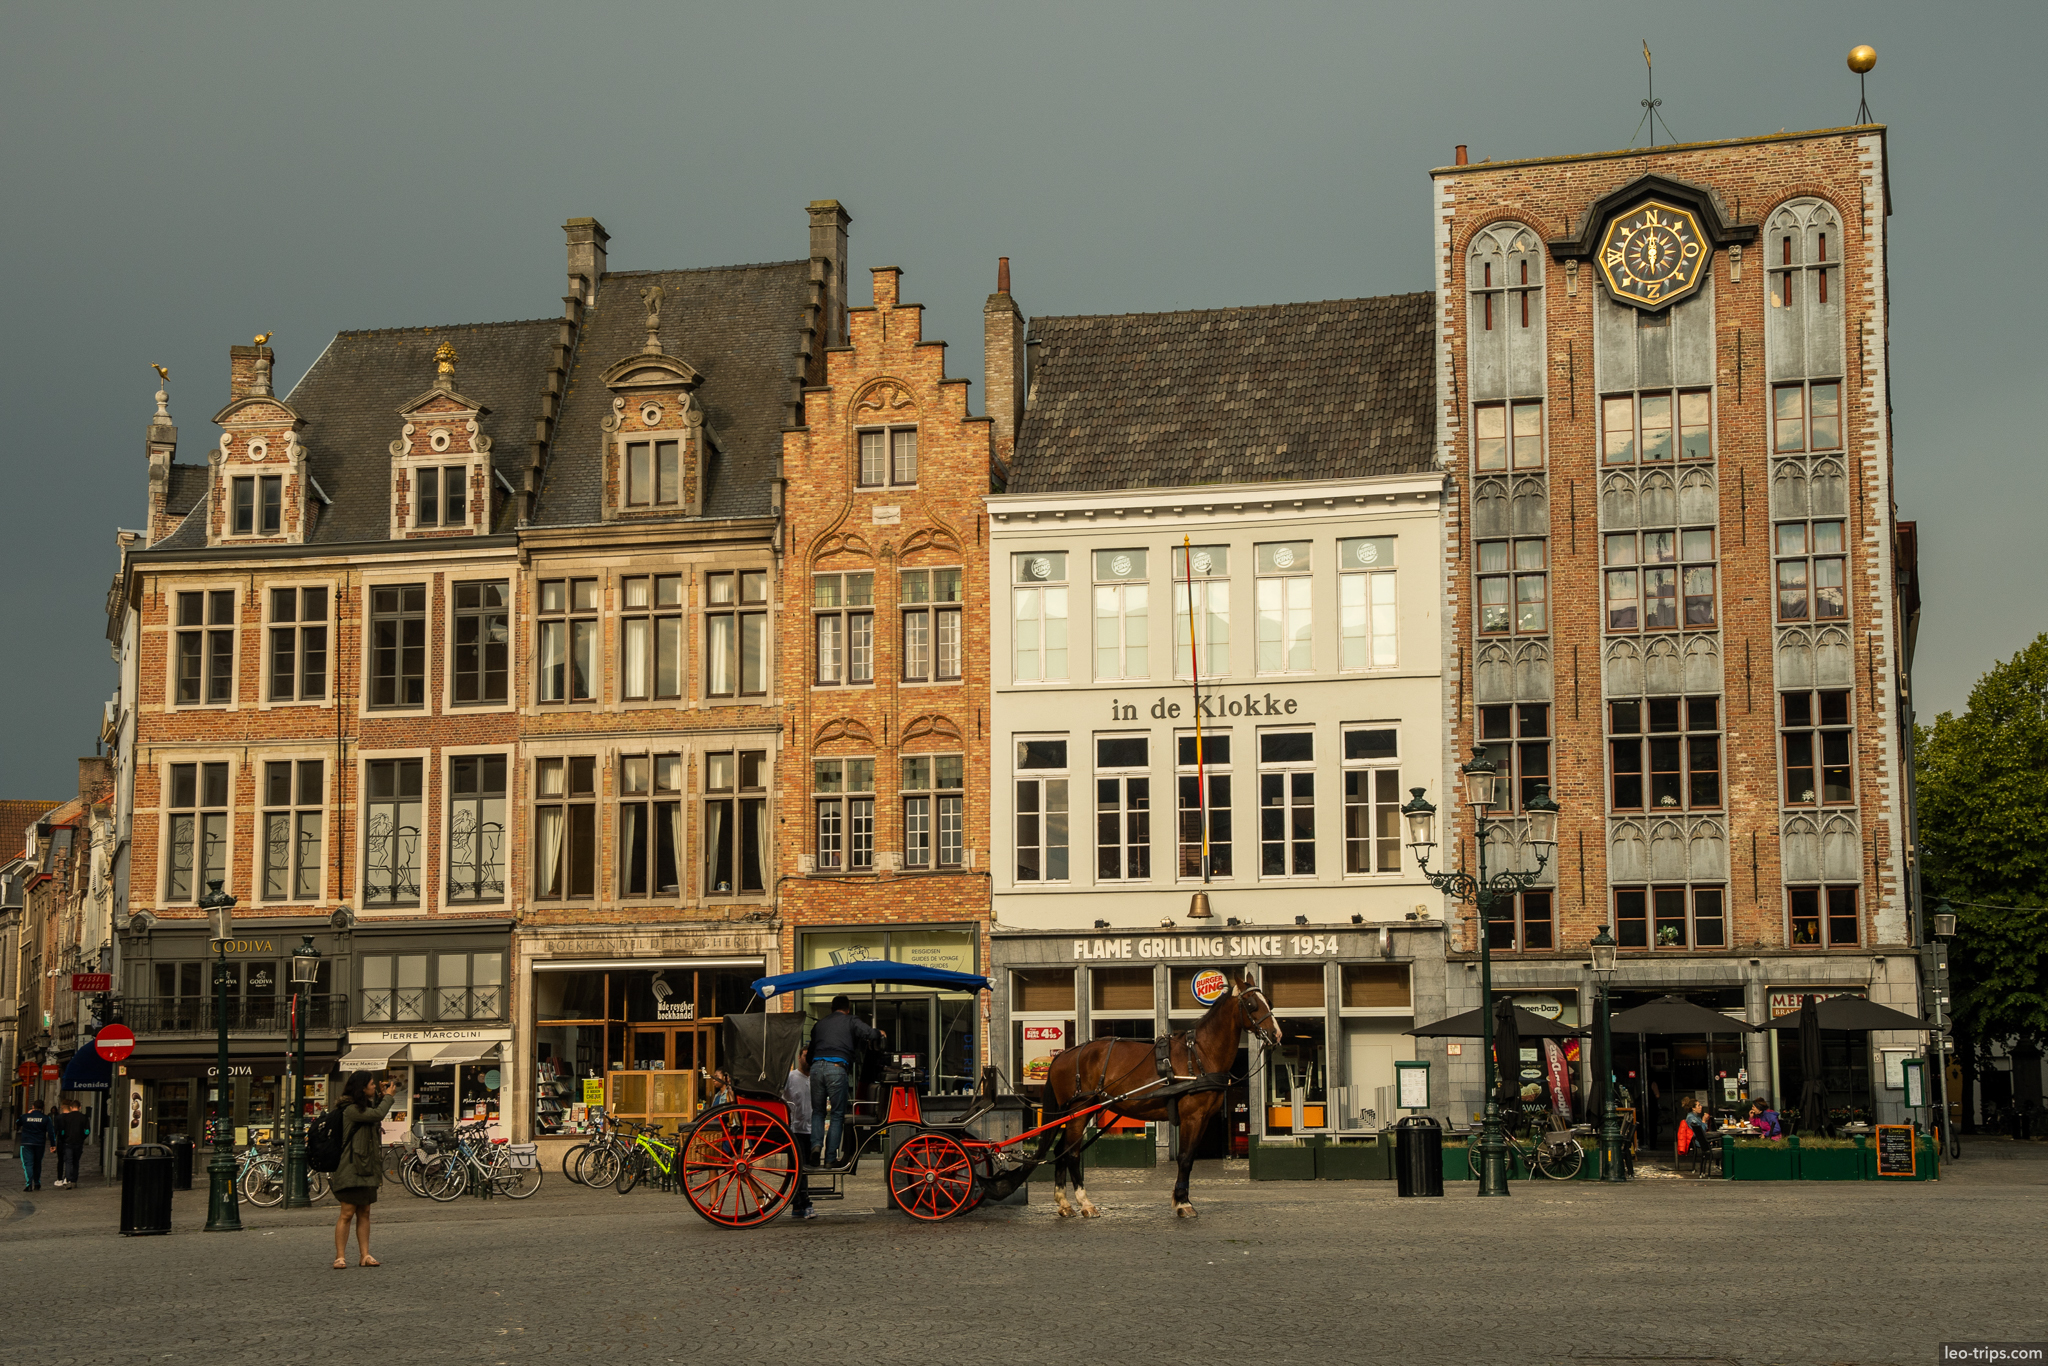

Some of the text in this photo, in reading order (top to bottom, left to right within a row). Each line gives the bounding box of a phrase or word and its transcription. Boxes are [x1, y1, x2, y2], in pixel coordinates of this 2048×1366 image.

[1645, 209, 1658, 226] N
[1683, 242, 1699, 258] O
[1607, 248, 1623, 268] W
[1647, 284, 1660, 298] Z
[1112, 693, 1298, 721] in de Klokke
[547, 936, 749, 950] BOEKHANDEL DE REYGHERE
[1073, 935, 1339, 959] FLAME GRILLING SINCE 1954
[1196, 975, 1223, 988] BURGER
[1197, 981, 1225, 997] KING
[662, 1001, 669, 1010] de
[657, 1010, 694, 1020] boekhandel
[423, 1031, 481, 1039] MARCOLINI
[964, 1035, 973, 1050] DE
[1522, 1104, 1547, 1112] AWAY
